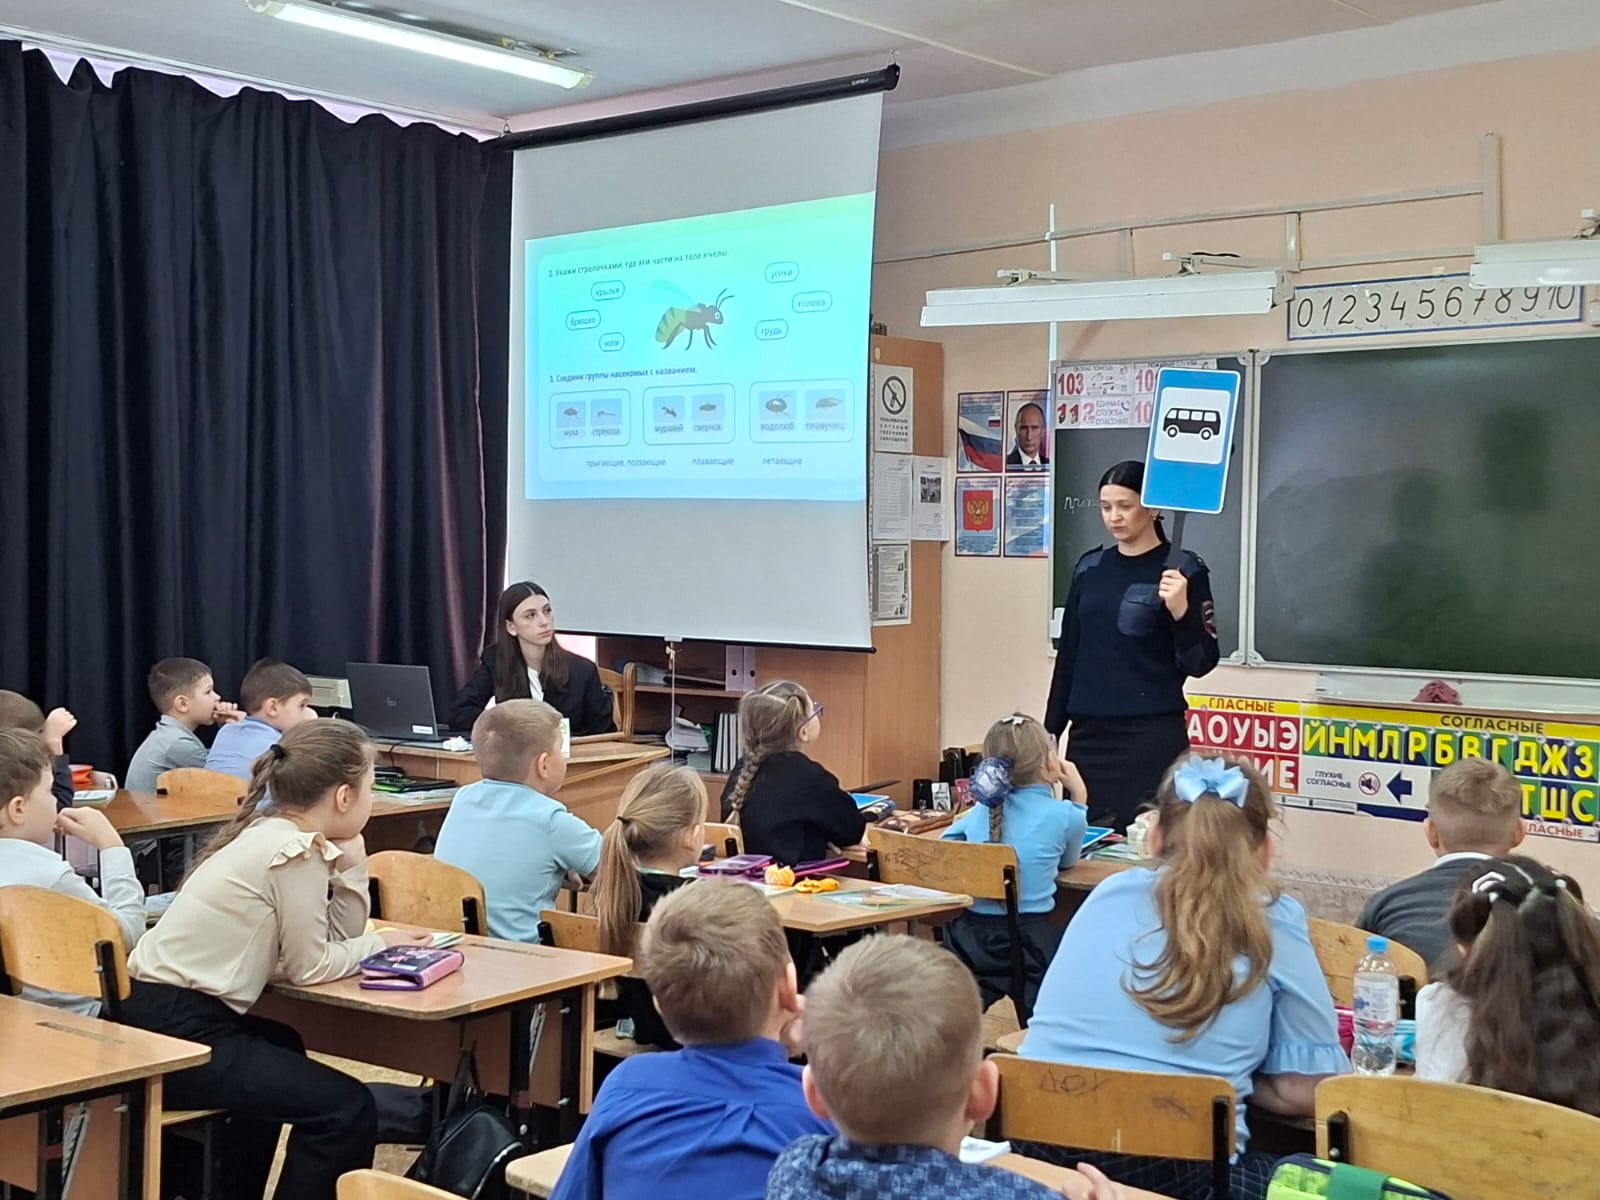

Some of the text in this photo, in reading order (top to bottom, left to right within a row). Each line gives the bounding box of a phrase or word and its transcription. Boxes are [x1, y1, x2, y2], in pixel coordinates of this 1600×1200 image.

[651, 256, 673, 267] части
[675, 254, 683, 262] на
[685, 253, 701, 261] теле
[595, 285, 620, 297] крылья
[796, 297, 826, 308] голова
[760, 325, 783, 337] грудь
[603, 337, 620, 348] ноги
[555, 372, 584, 384] Соедини
[584, 371, 609, 382] группы
[609, 369, 649, 380] насекомых
[1136, 368, 1156, 393] 10
[1058, 372, 1084, 396] 103
[1135, 399, 1152, 425] 10
[760, 420, 845, 433] водолюб плавунец
[761, 456, 802, 467] летающие
[1209, 697, 1276, 713] ГЛАСНЫЕ
[1441, 715, 1545, 734] СОГЛАСНЫЕ
[1314, 769, 1343, 780] ГЛУХИЕ
[1306, 777, 1352, 789] СОГЛАСНЫЕ
[1528, 823, 1584, 838] ЛАСНЫЕ
